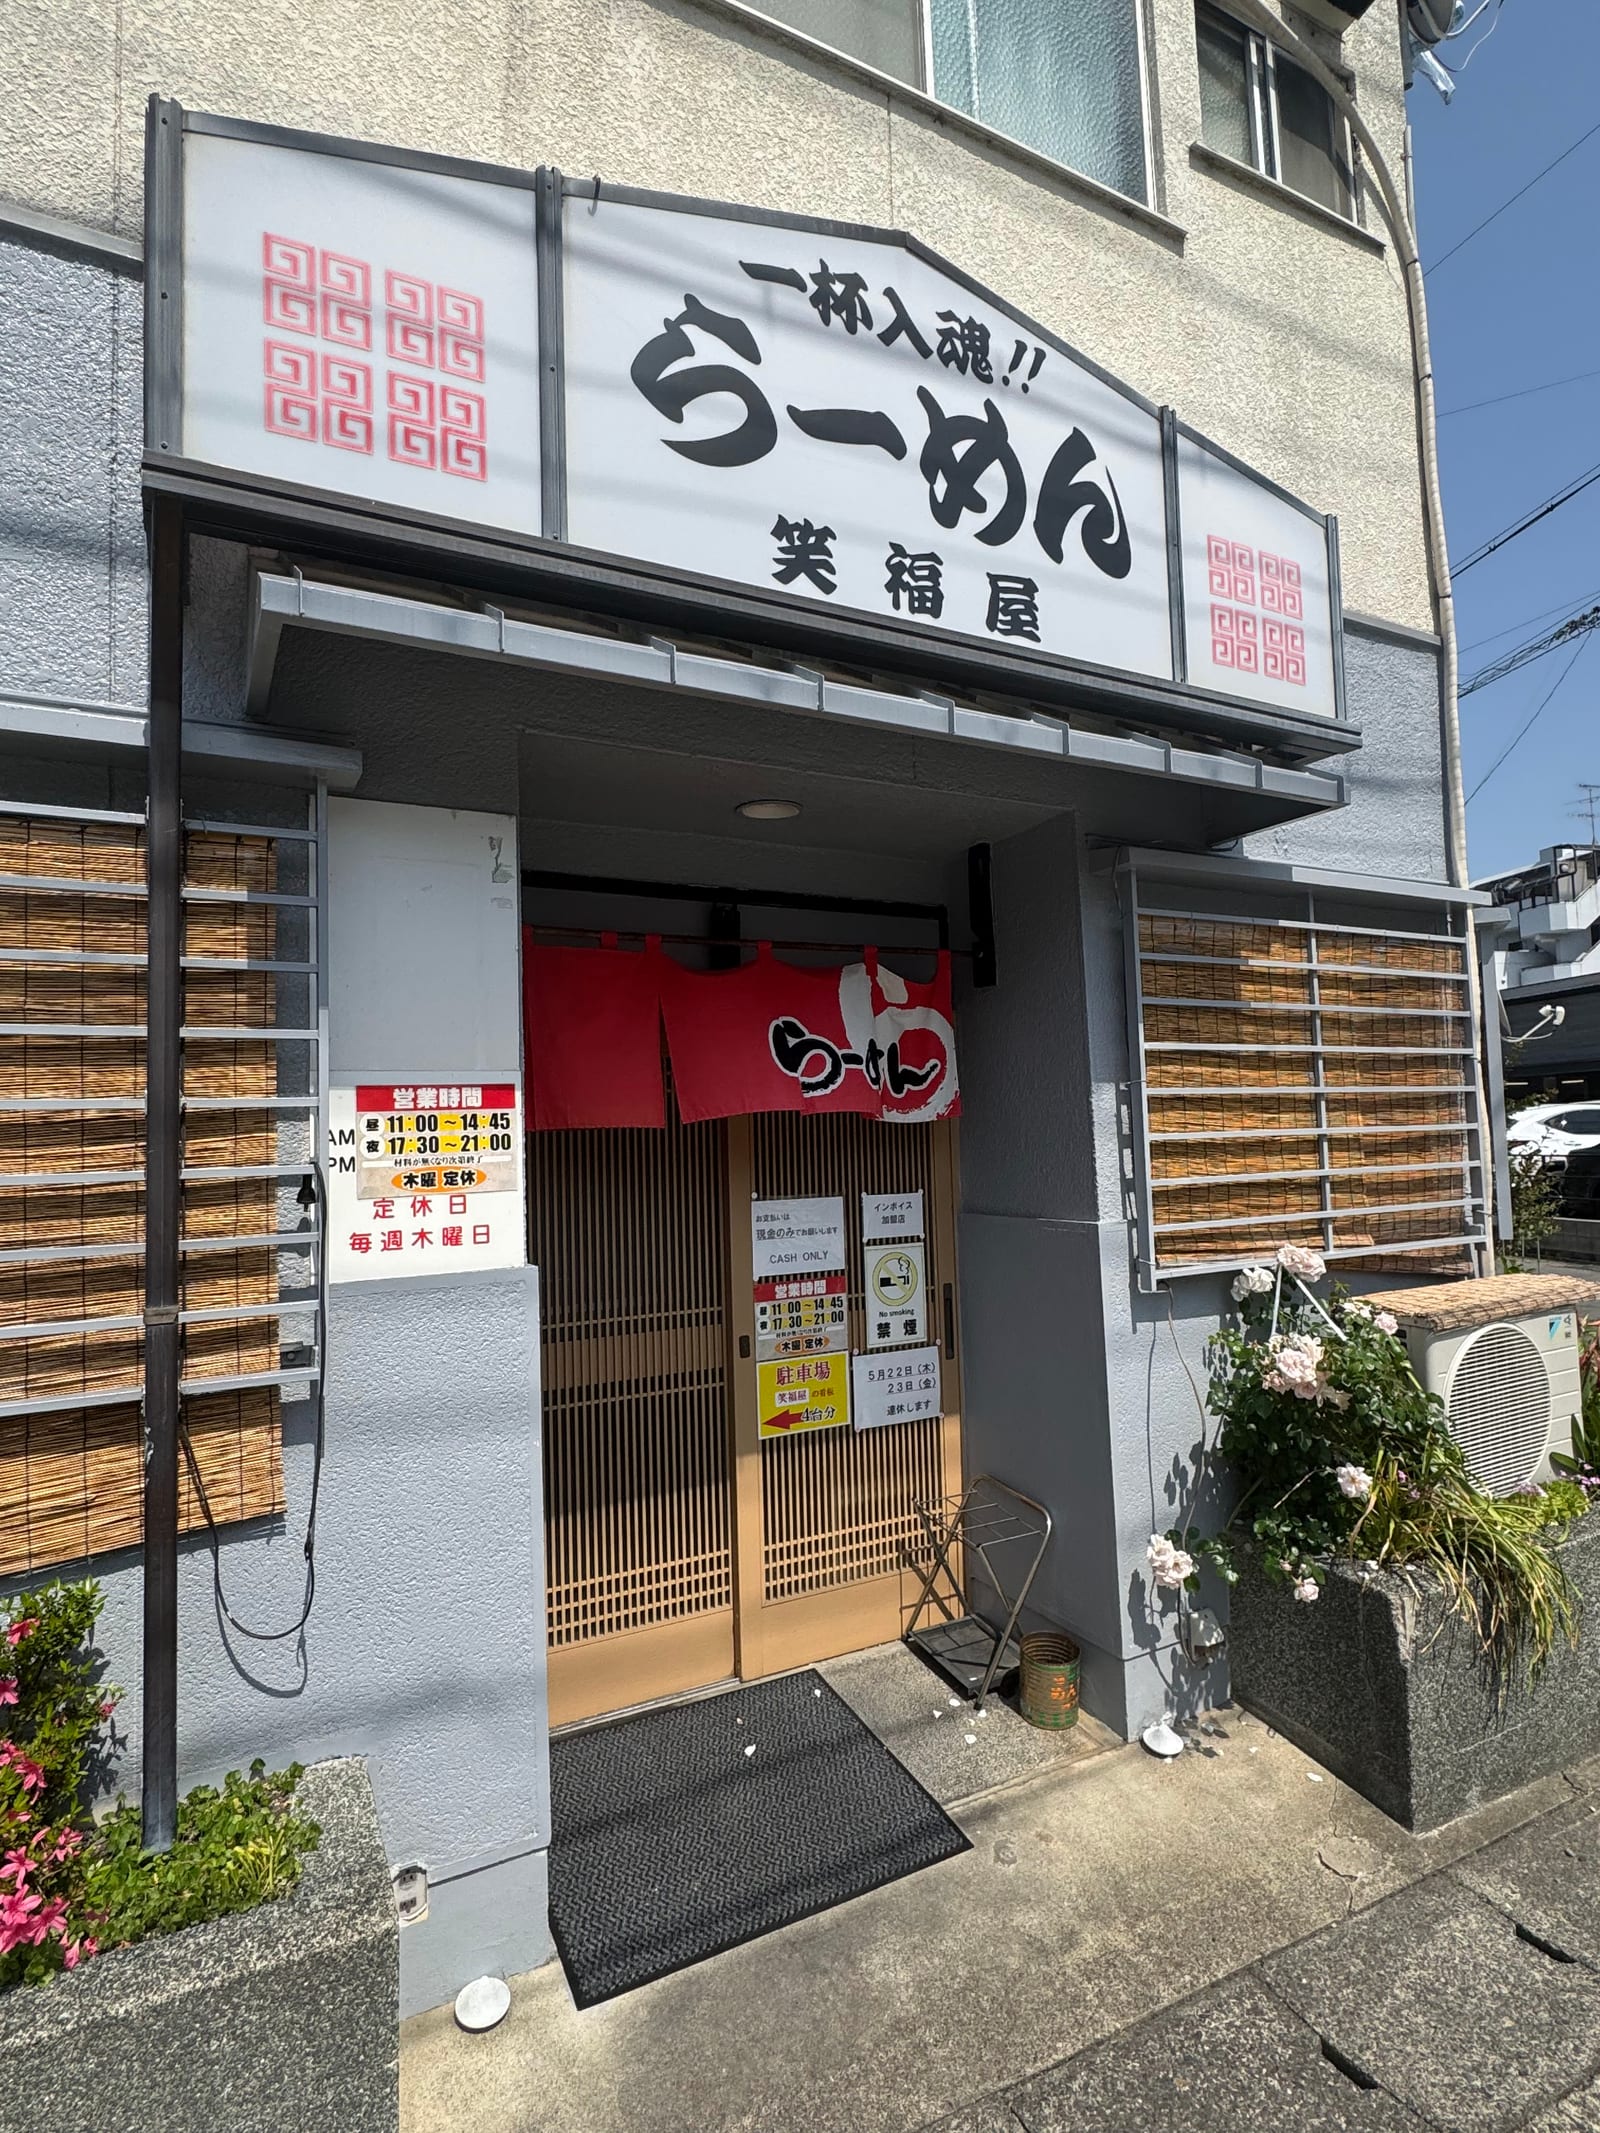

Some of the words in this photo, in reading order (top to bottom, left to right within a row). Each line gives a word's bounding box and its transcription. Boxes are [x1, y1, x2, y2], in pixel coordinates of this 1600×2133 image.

[739, 258, 1046, 393] 一杯入魂!!
[630, 293, 1131, 579] らーめん
[770, 514, 1042, 643] 笑福屋
[770, 1017, 940, 1096] らーめん
[393, 1087, 483, 1109] 営業時間
[365, 1119, 379, 1132] 昼
[366, 1140, 379, 1153] 夜
[403, 1172, 436, 1189] 木曜
[443, 1170, 476, 1186] 定休
[373, 1194, 467, 1220] 定休日
[874, 1201, 913, 1212] インボイス
[755, 1213, 790, 1223] お支払いは
[349, 1224, 490, 1253] 毎週木曜日
[756, 1227, 838, 1241] 現金のみでお願いします
[769, 1253, 798, 1264] CASH
[802, 1250, 829, 1261] ONLY
[775, 1280, 826, 1299] 営業時間
[889, 1308, 914, 1317] smoking
[877, 1319, 918, 1339] 禁煙
[805, 1337, 824, 1349] 定休
[776, 1361, 831, 1386] 駐車場
[801, 1406, 836, 1422] 4台分
[886, 1399, 932, 1416] 連休します
